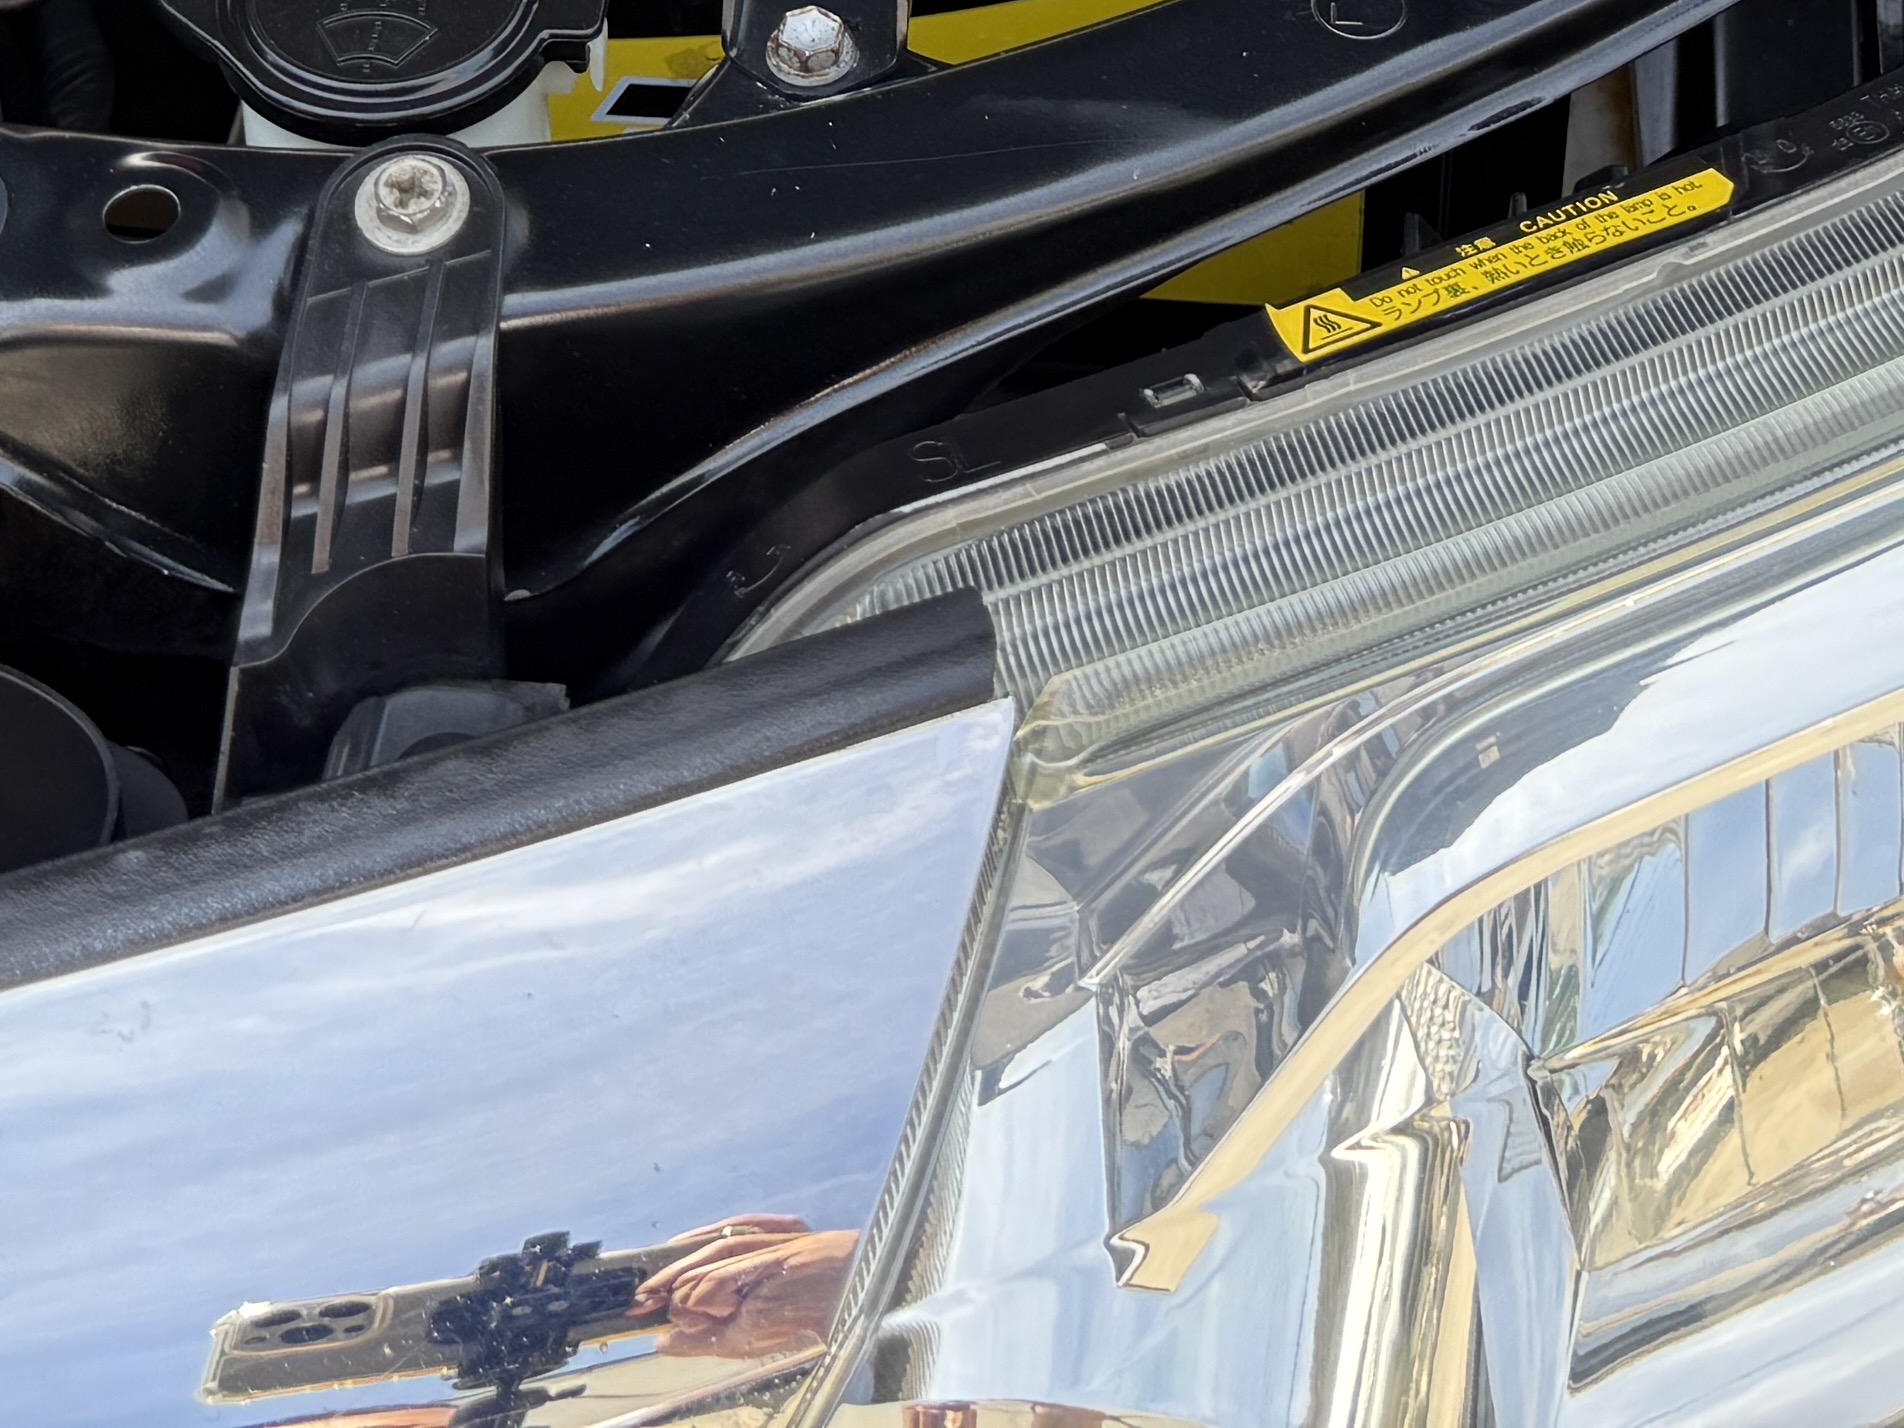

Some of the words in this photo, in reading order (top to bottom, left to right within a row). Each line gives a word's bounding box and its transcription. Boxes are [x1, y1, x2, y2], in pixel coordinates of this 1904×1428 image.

[1370, 294, 1393, 309] Do
[1397, 280, 1422, 298] not
[1425, 265, 1467, 290] touch
[1471, 251, 1508, 272] when
[1510, 240, 1533, 258] the
[1535, 226, 1571, 248] back
[1575, 216, 1593, 232] of
[1595, 207, 1619, 224] the
[1621, 196, 1654, 217] lamp
[1658, 189, 1672, 203] is
[1519, 188, 1621, 235] CAUTION
